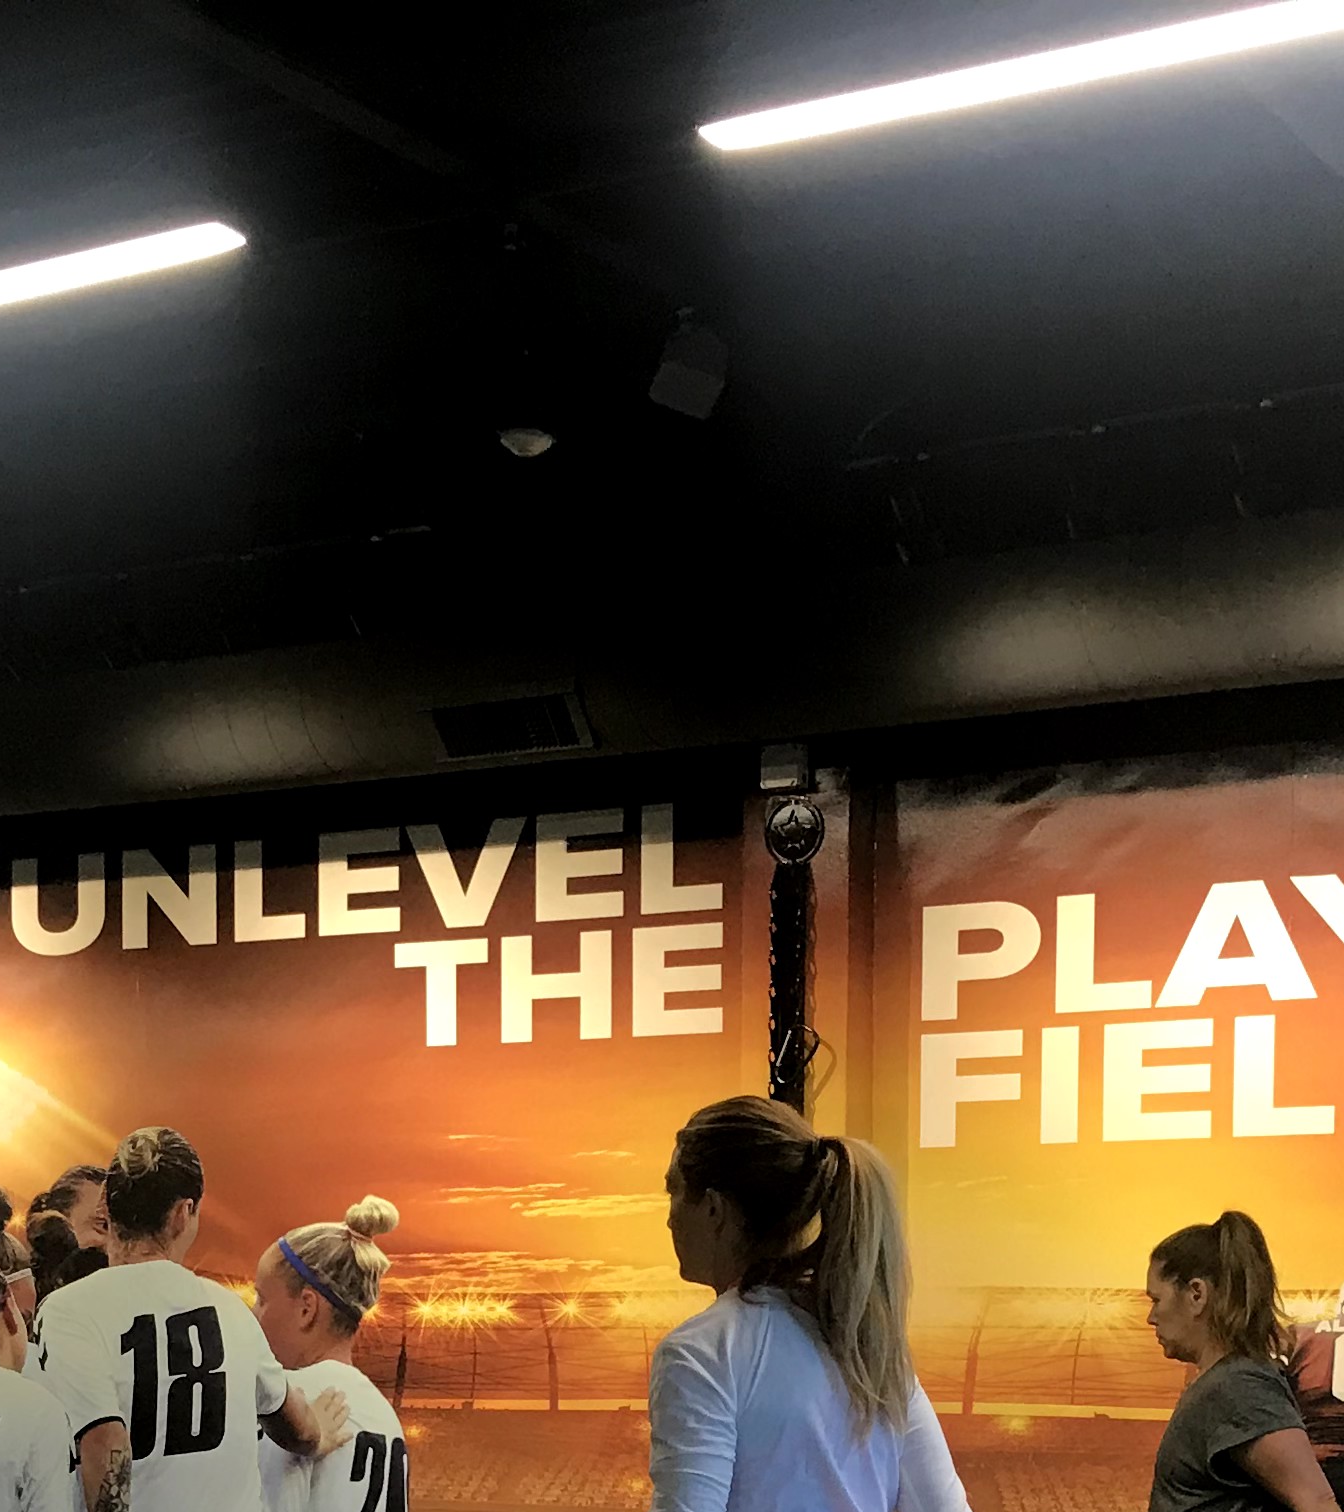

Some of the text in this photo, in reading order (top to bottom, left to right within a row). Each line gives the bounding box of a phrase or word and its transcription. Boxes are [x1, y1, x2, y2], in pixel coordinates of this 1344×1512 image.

[10, 802, 725, 956] UNLEVEL
[394, 921, 724, 1047] THE
[120, 1306, 227, 1461] 18
